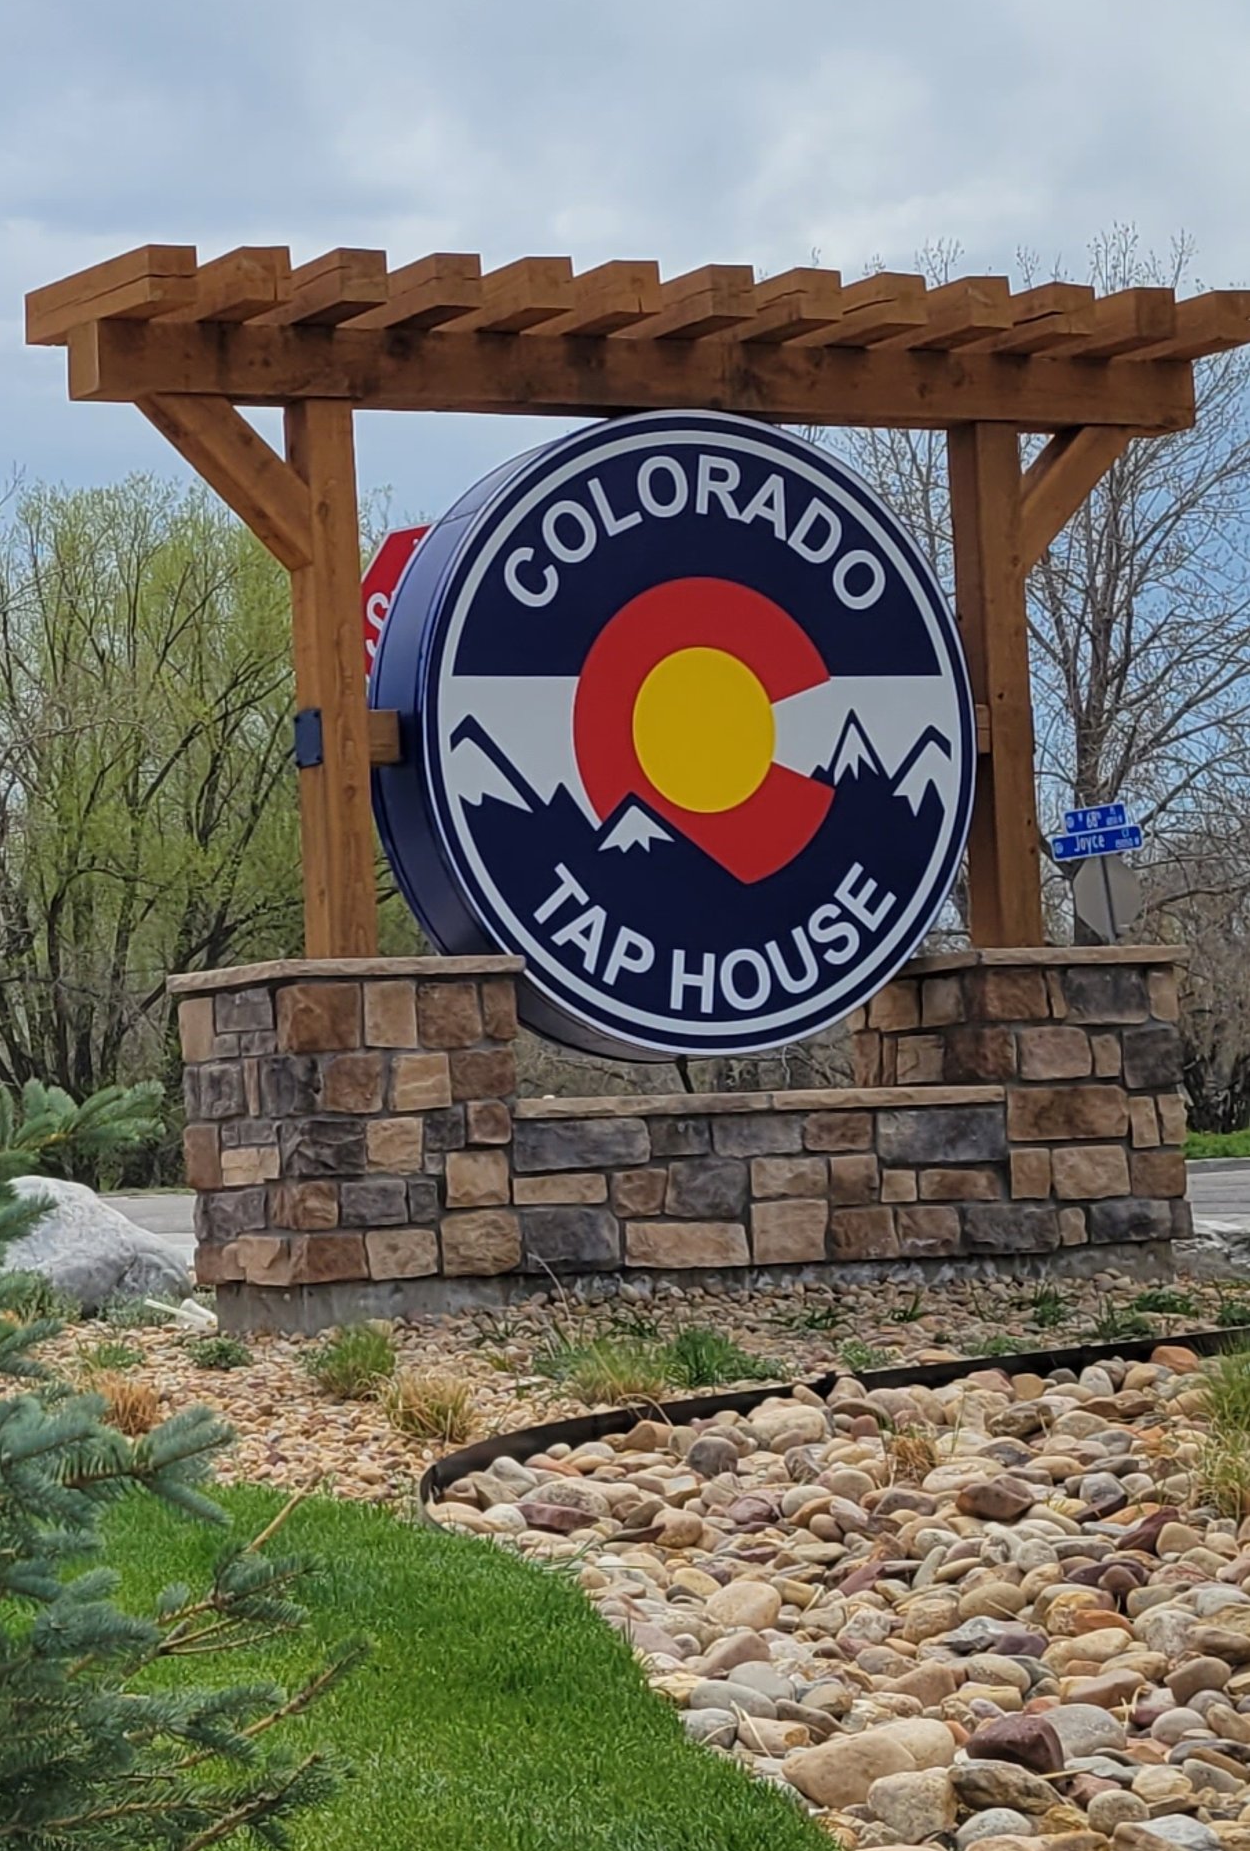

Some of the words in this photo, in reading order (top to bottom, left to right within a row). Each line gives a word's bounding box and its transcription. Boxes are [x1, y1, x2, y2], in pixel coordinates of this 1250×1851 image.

[504, 454, 886, 610] COLORADO
[1074, 834, 1105, 854] Joyce
[533, 862, 655, 986] TAP
[669, 862, 897, 1014] HOUSE
